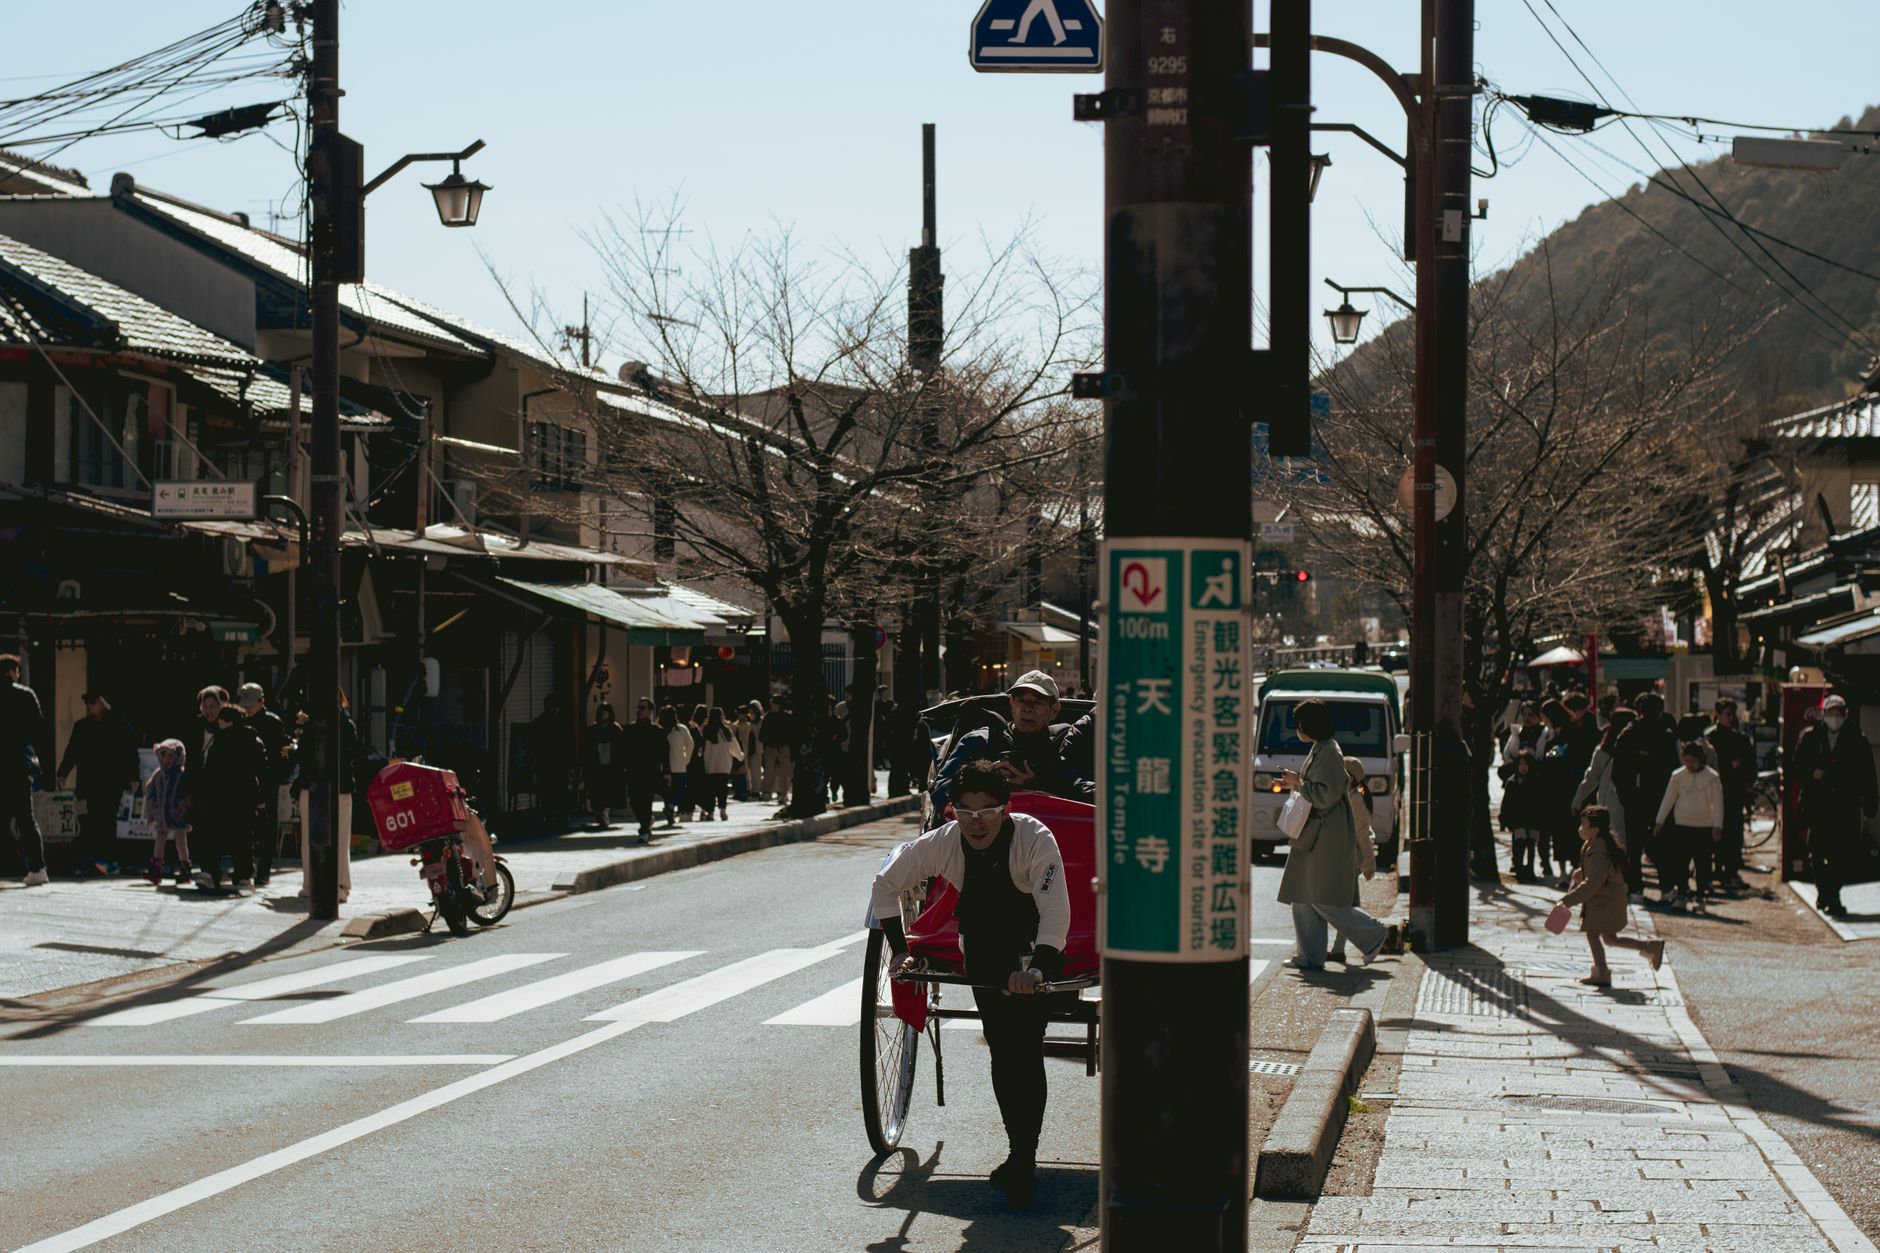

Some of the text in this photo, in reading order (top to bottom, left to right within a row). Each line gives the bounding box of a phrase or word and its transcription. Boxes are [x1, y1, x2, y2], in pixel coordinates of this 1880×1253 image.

[1147, 56, 1188, 75] 9295
[1147, 87, 1188, 105] 京都市
[1118, 616, 1169, 639] 100m
[385, 809, 417, 831] 601
[1110, 680, 1131, 865] Tenryuji Temple
[1135, 677, 1172, 874] 天龍寺
[1190, 620, 1210, 951] Emergency evacuation site for tourists
[1209, 620, 1241, 951] 観光客緊急避難広場
